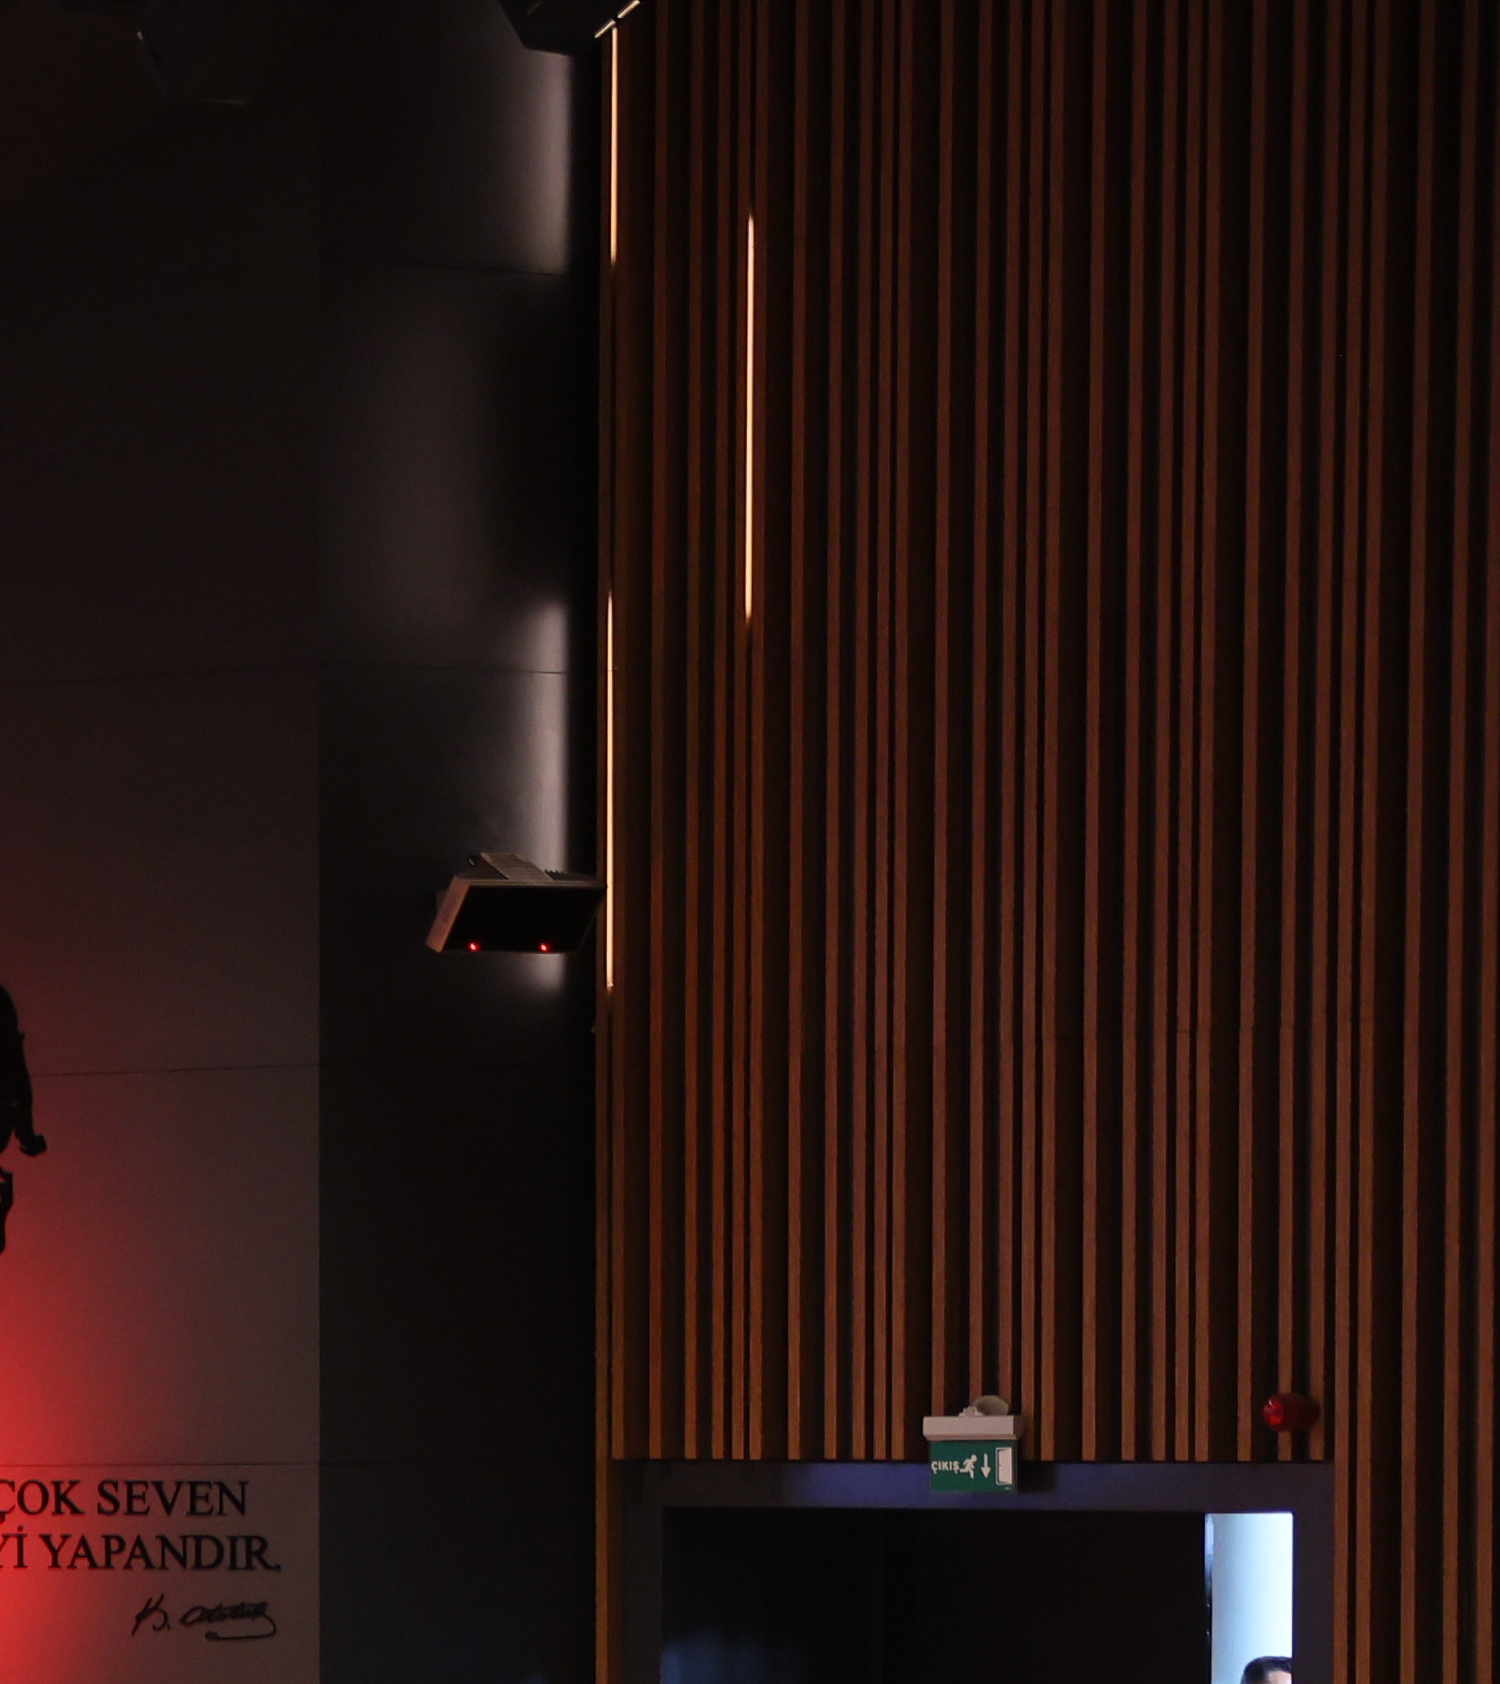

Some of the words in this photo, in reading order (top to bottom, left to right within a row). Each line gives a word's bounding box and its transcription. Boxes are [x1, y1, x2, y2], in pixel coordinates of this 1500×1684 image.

[931, 1461, 960, 1475] ÇIKIŞ
[96, 1479, 248, 1516] SEVEN
[41, 1533, 282, 1573] YAPANDIR.
